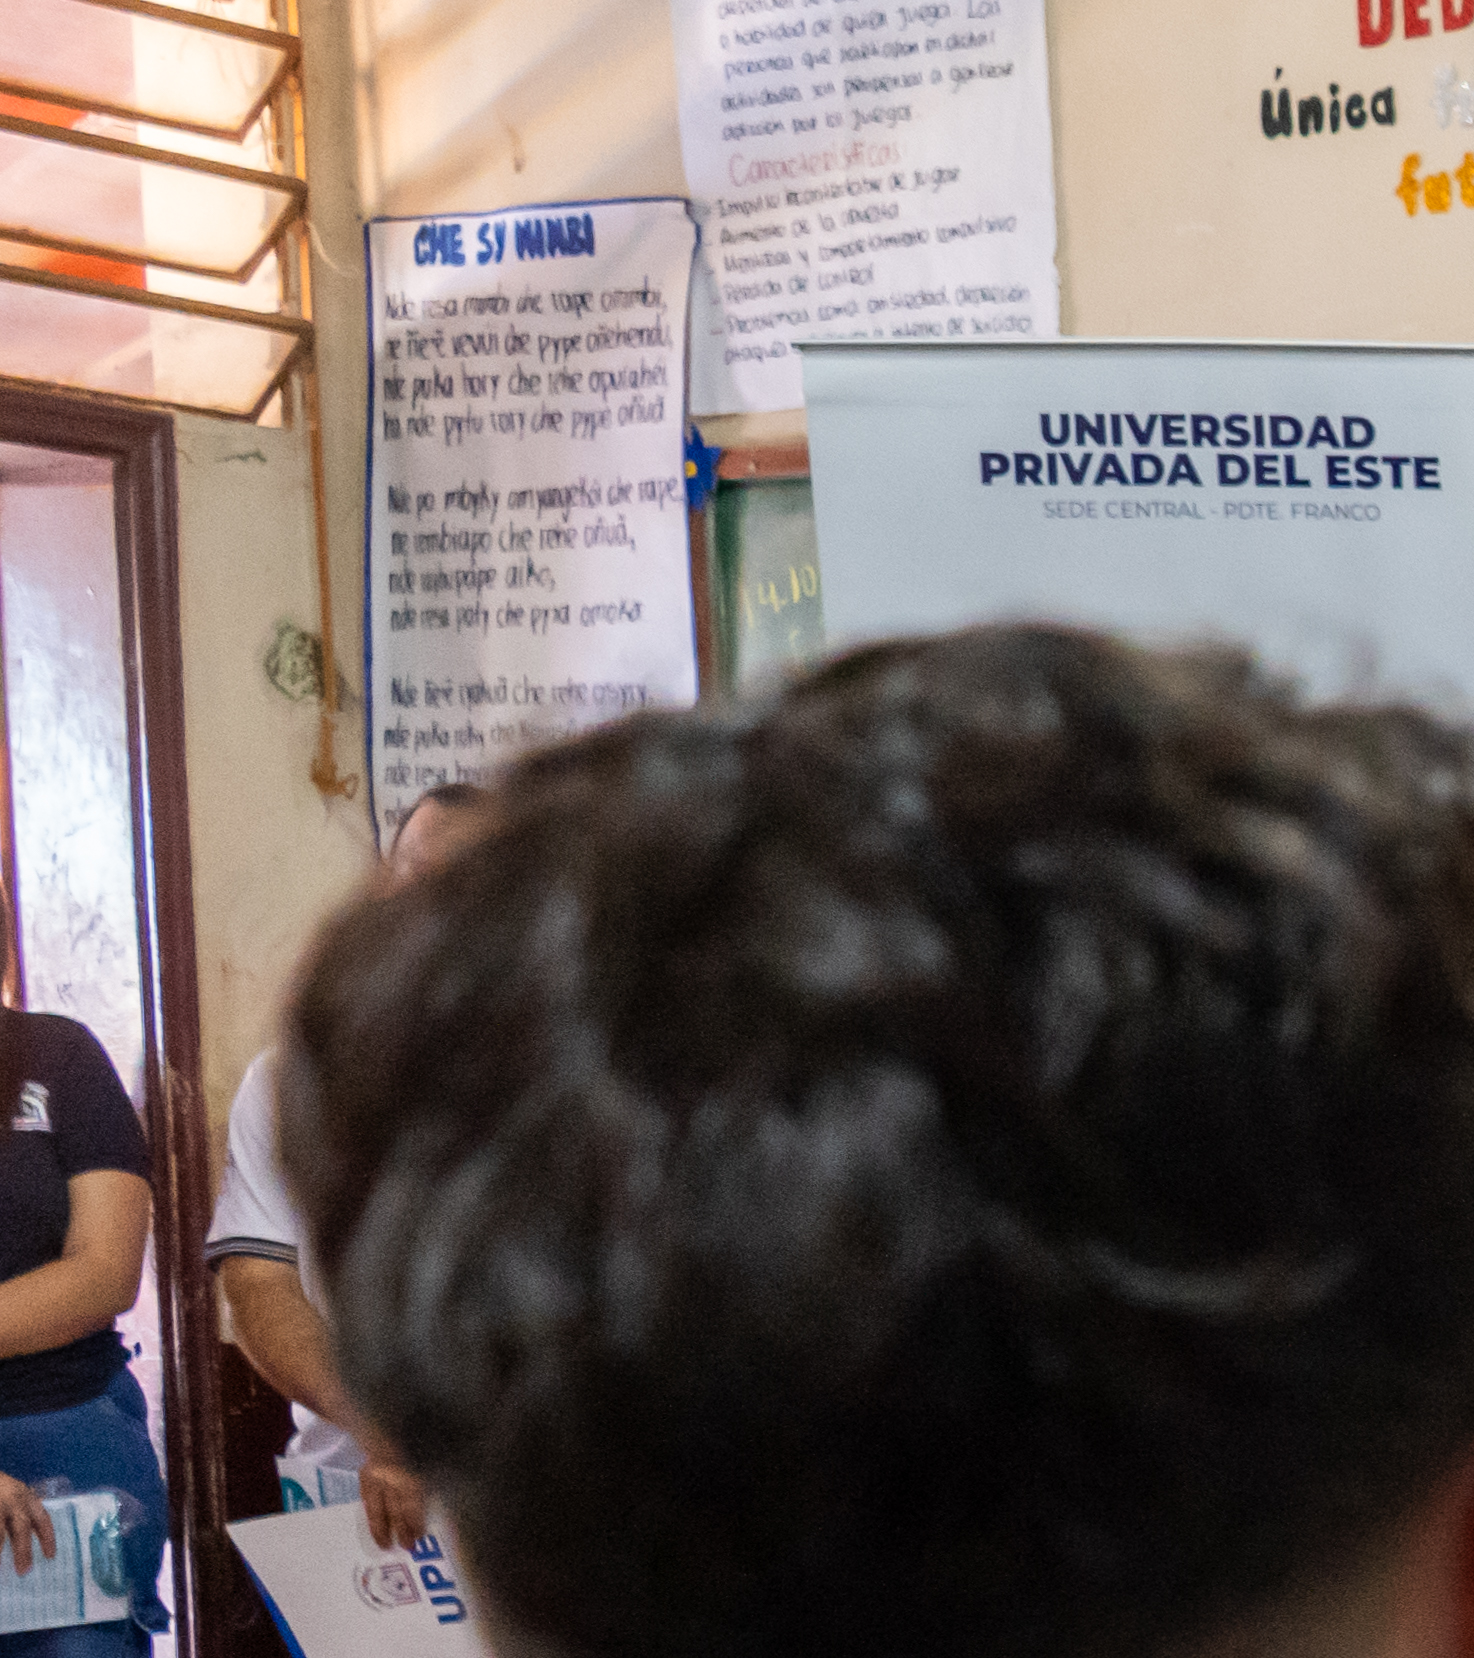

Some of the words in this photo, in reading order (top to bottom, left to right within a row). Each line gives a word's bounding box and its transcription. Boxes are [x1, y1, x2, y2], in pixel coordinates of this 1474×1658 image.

[1040, 412, 1377, 449] UNIVERSIDAD
[979, 451, 1203, 487] PRIVADA
[1216, 453, 1311, 488] DEL
[1326, 455, 1442, 490] ESTE
[1043, 500, 1098, 519] SEDE
[1105, 501, 1205, 521] CENTRAL
[1291, 502, 1382, 522] FRANCO
[408, 1533, 467, 1625] UPE
